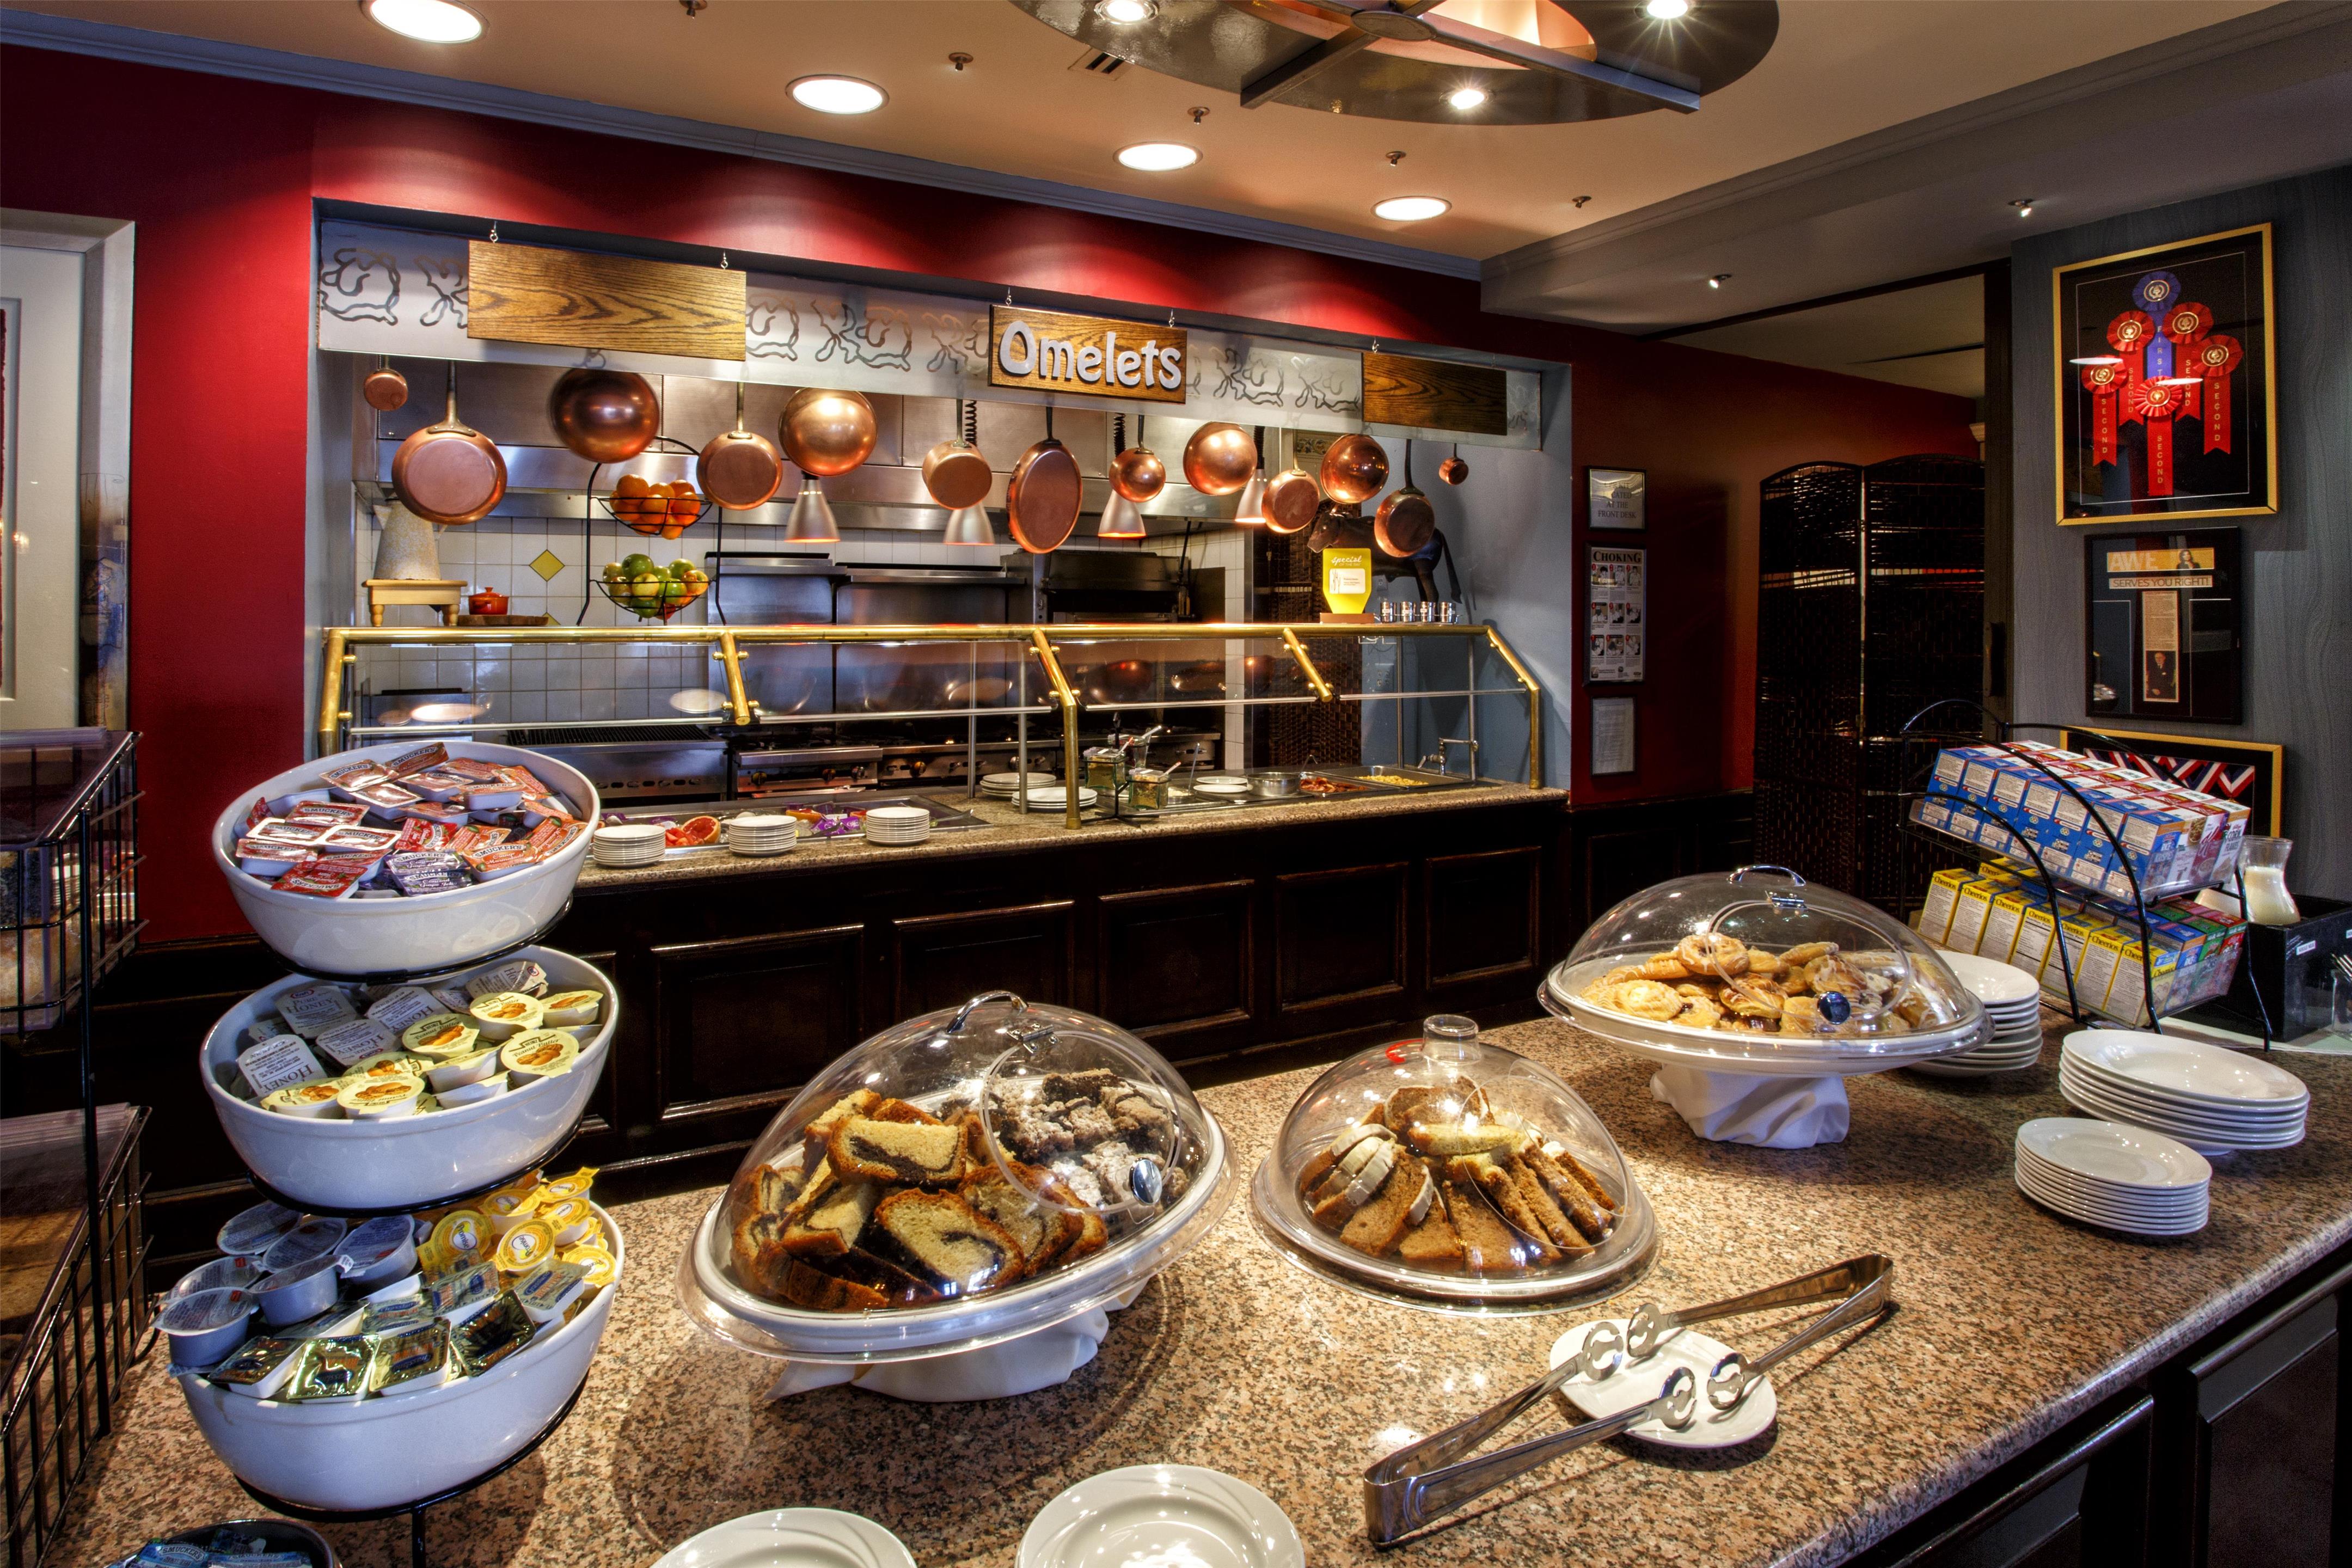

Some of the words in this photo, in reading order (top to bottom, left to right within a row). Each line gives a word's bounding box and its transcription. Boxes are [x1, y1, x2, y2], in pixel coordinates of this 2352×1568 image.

[1000, 320, 1181, 389] Omelets
[1331, 555, 1362, 566] special
[2113, 579, 2150, 587] SERVES
[2151, 578, 2172, 587] YOU
[474, 844, 523, 858] SMUCKER'S
[486, 854, 524, 865] Marmalade
[292, 879, 341, 889] SMUCKER'S
[1934, 875, 1957, 889] Cheerios
[1964, 887, 1987, 901] Cheerios
[1996, 898, 2020, 912] Cheerios
[2029, 910, 2051, 923] Cheerios
[2062, 923, 2084, 936] Cheerios
[2092, 936, 2118, 952] Cheerios
[286, 998, 333, 1013] HONEY
[392, 1006, 434, 1033] HONEY
[414, 1029, 437, 1040] Peanut
[438, 1020, 461, 1030] Butter
[336, 1034, 384, 1054] HONEY
[512, 1046, 536, 1057] Peanut
[537, 1038, 559, 1048] Butter
[263, 1064, 314, 1092] HONEY
[457, 1225, 470, 1248] Promise
[518, 1235, 531, 1257] Promise
[164, 1546, 204, 1561] SMUCKER'S
